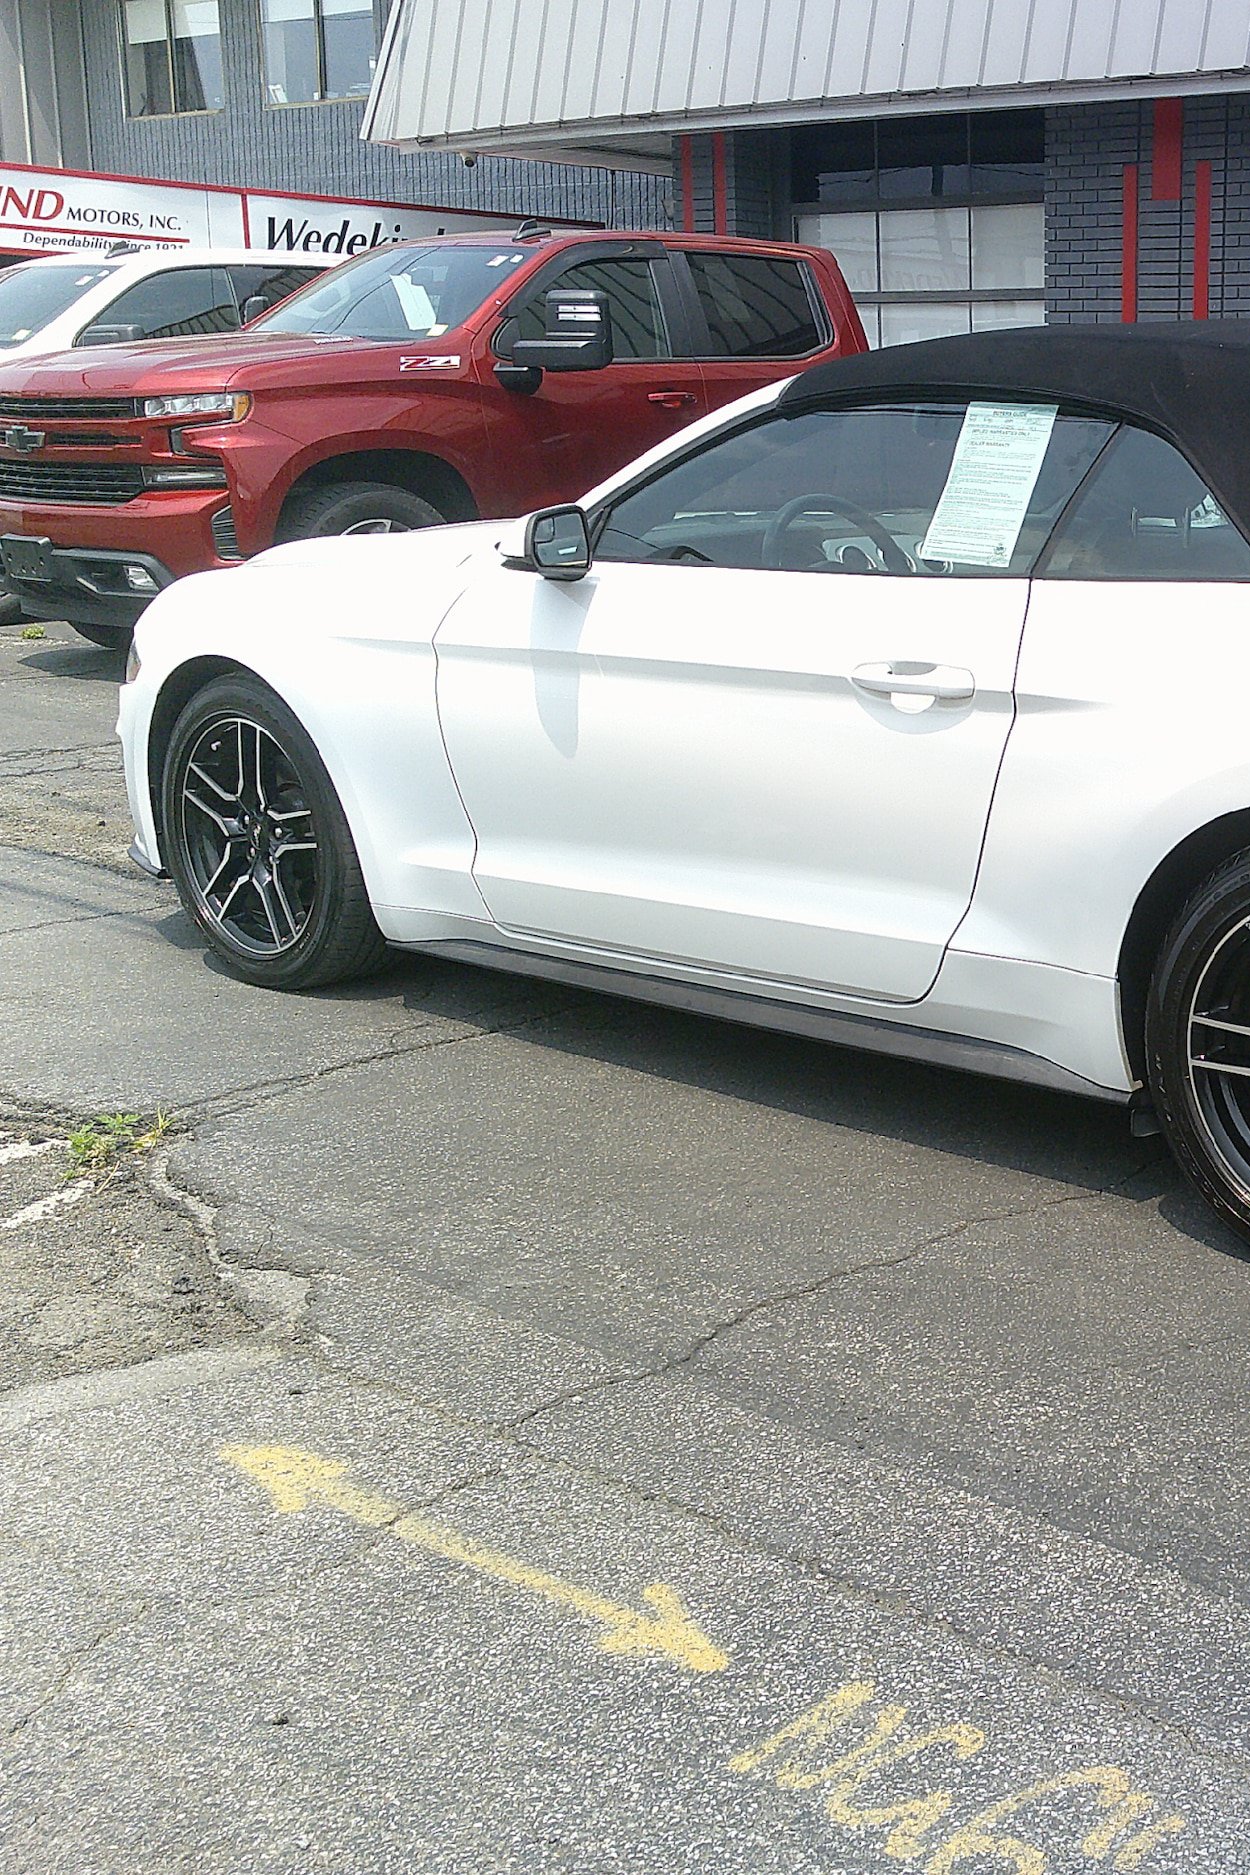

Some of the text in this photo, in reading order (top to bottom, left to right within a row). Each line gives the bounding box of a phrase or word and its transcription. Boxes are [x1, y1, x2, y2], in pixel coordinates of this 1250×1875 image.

[0, 185, 182, 231] ND MOTORS, INC.
[23, 232, 115, 250] Dependability
[126, 240, 151, 250] ince
